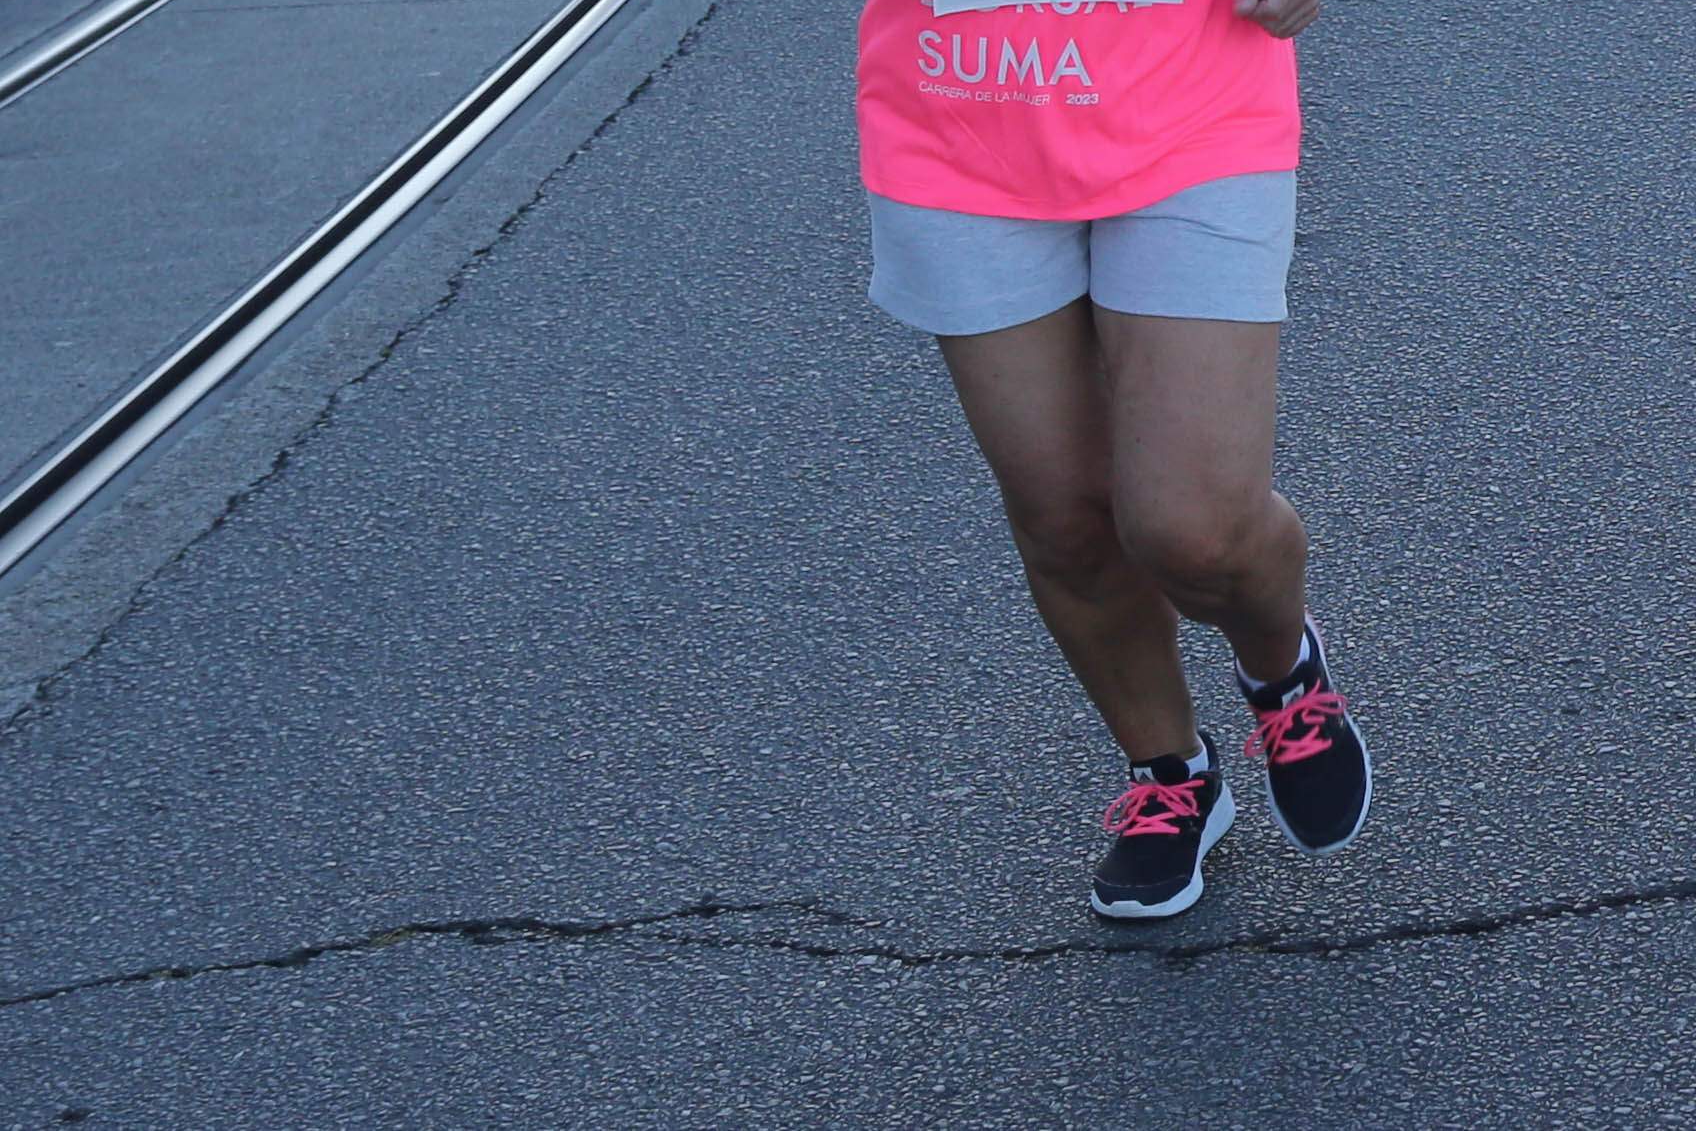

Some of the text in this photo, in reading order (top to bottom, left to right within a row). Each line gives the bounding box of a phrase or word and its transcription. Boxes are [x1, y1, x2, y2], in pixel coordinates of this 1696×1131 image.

[918, 30, 1092, 86] SUMA
[919, 81, 1099, 106] CARRERA DE LA MUJER 2023
